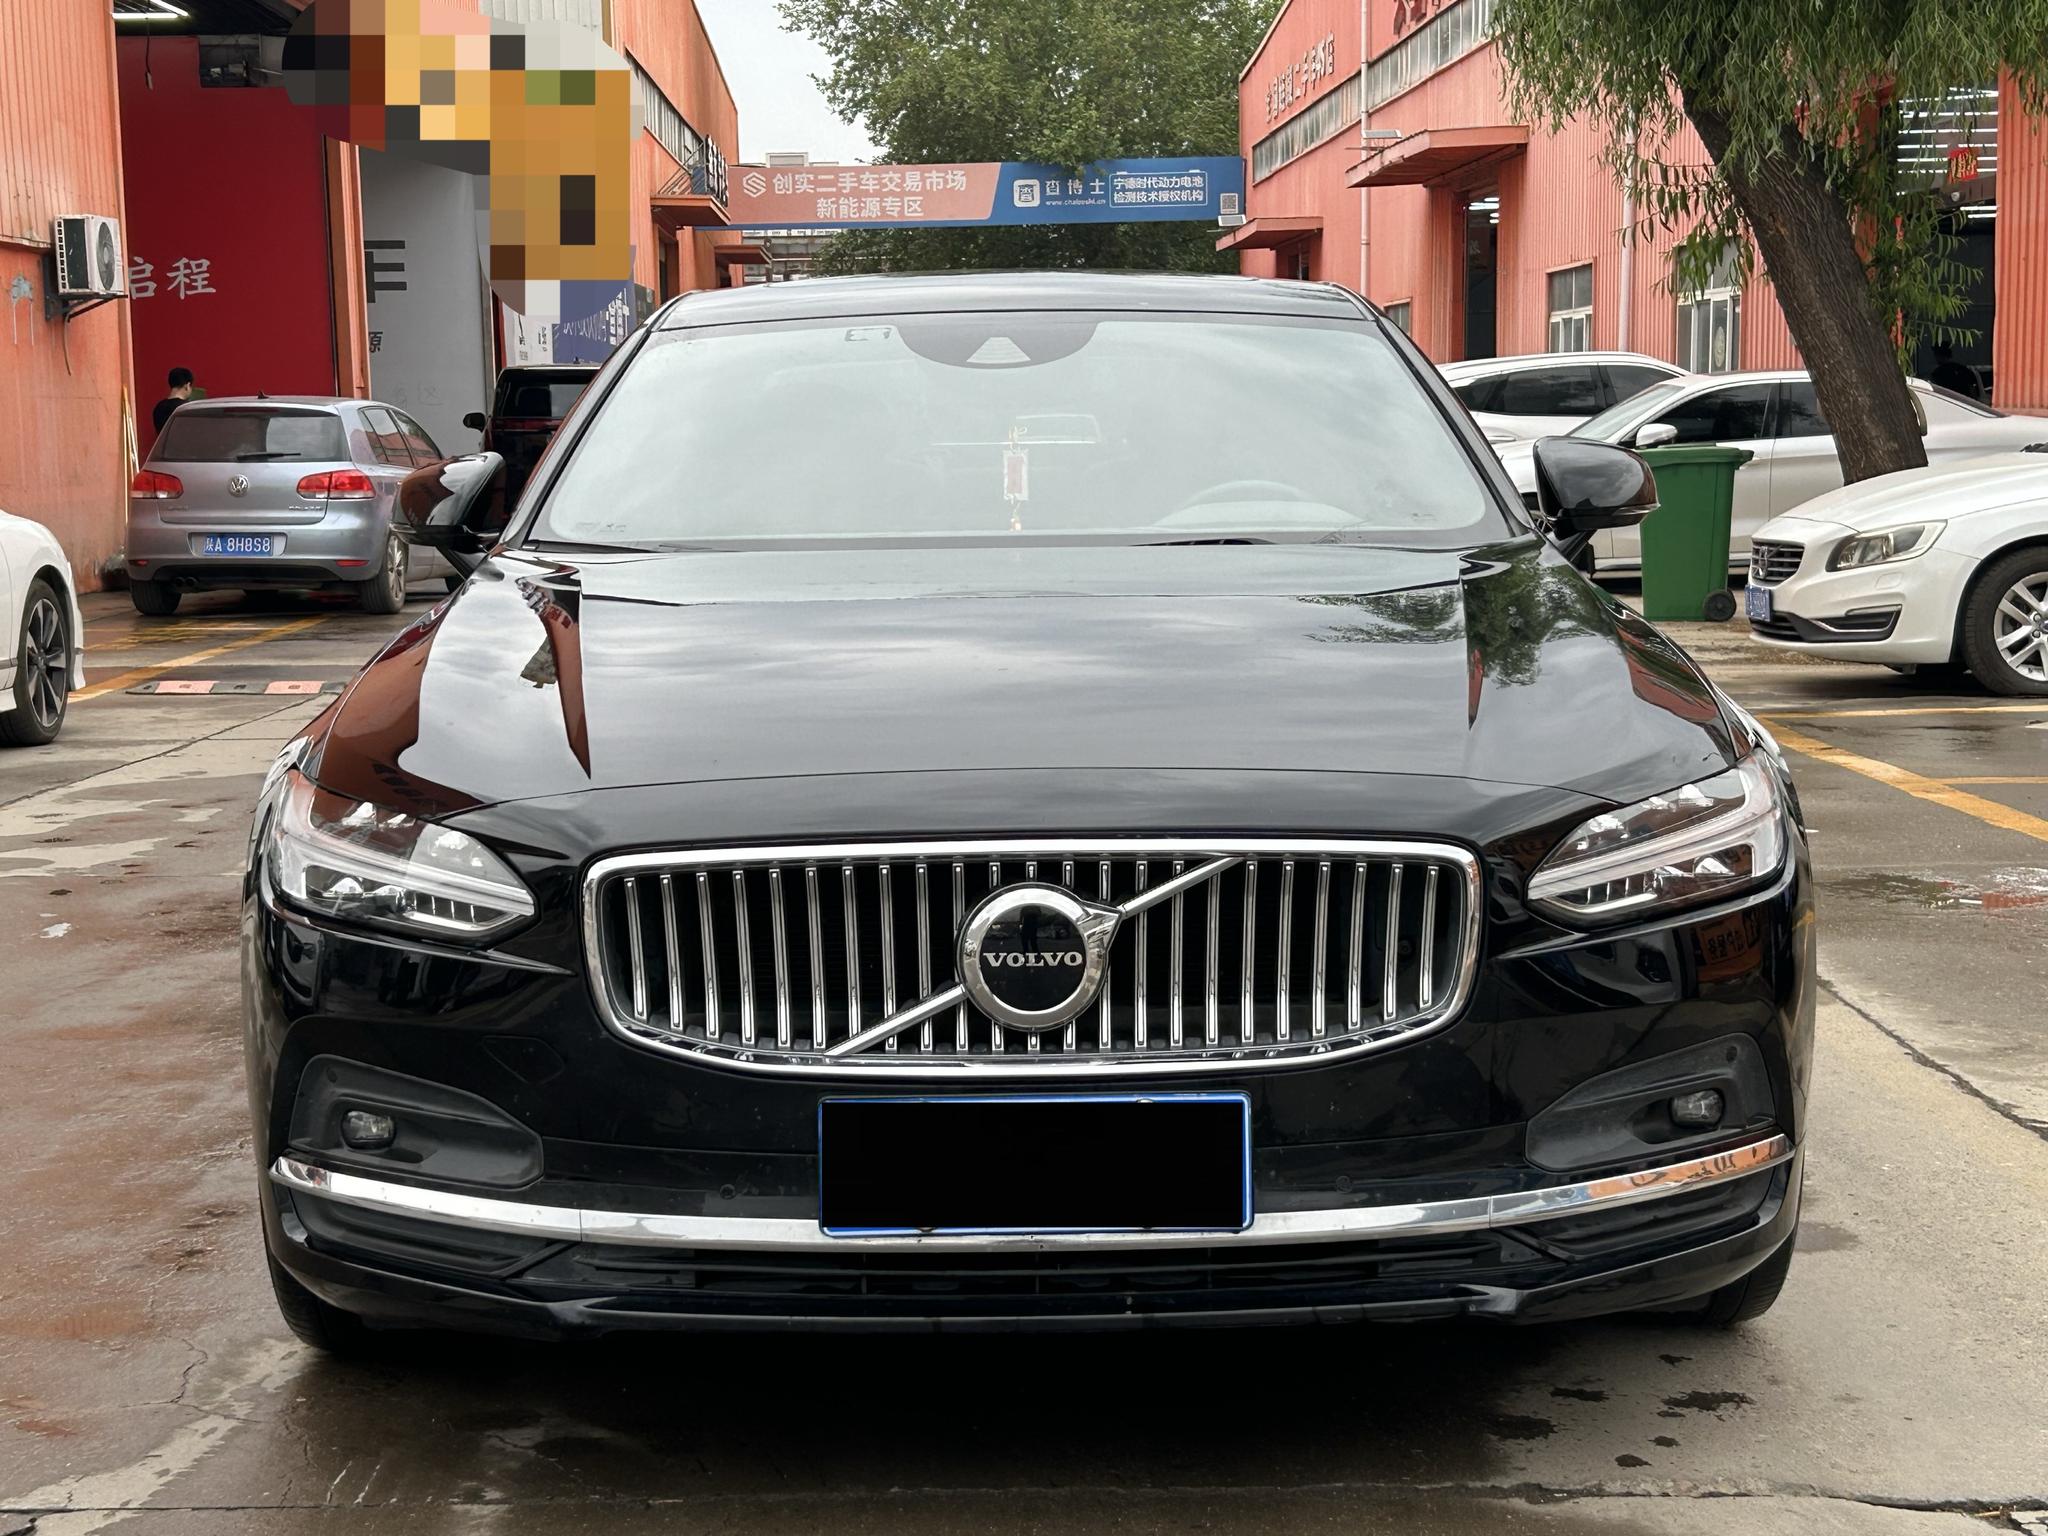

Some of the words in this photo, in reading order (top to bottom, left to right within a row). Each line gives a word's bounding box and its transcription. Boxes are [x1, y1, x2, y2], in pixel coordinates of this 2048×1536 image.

[772, 170, 967, 194] 创实二手车交易市场
[1113, 176, 1204, 189] 宁德时代动力电池
[1113, 190, 1204, 204] 检测技术授权机构
[816, 196, 925, 219] 新能源专区
[128, 256, 217, 300] 启程
[982, 951, 1083, 967] VOLVO
